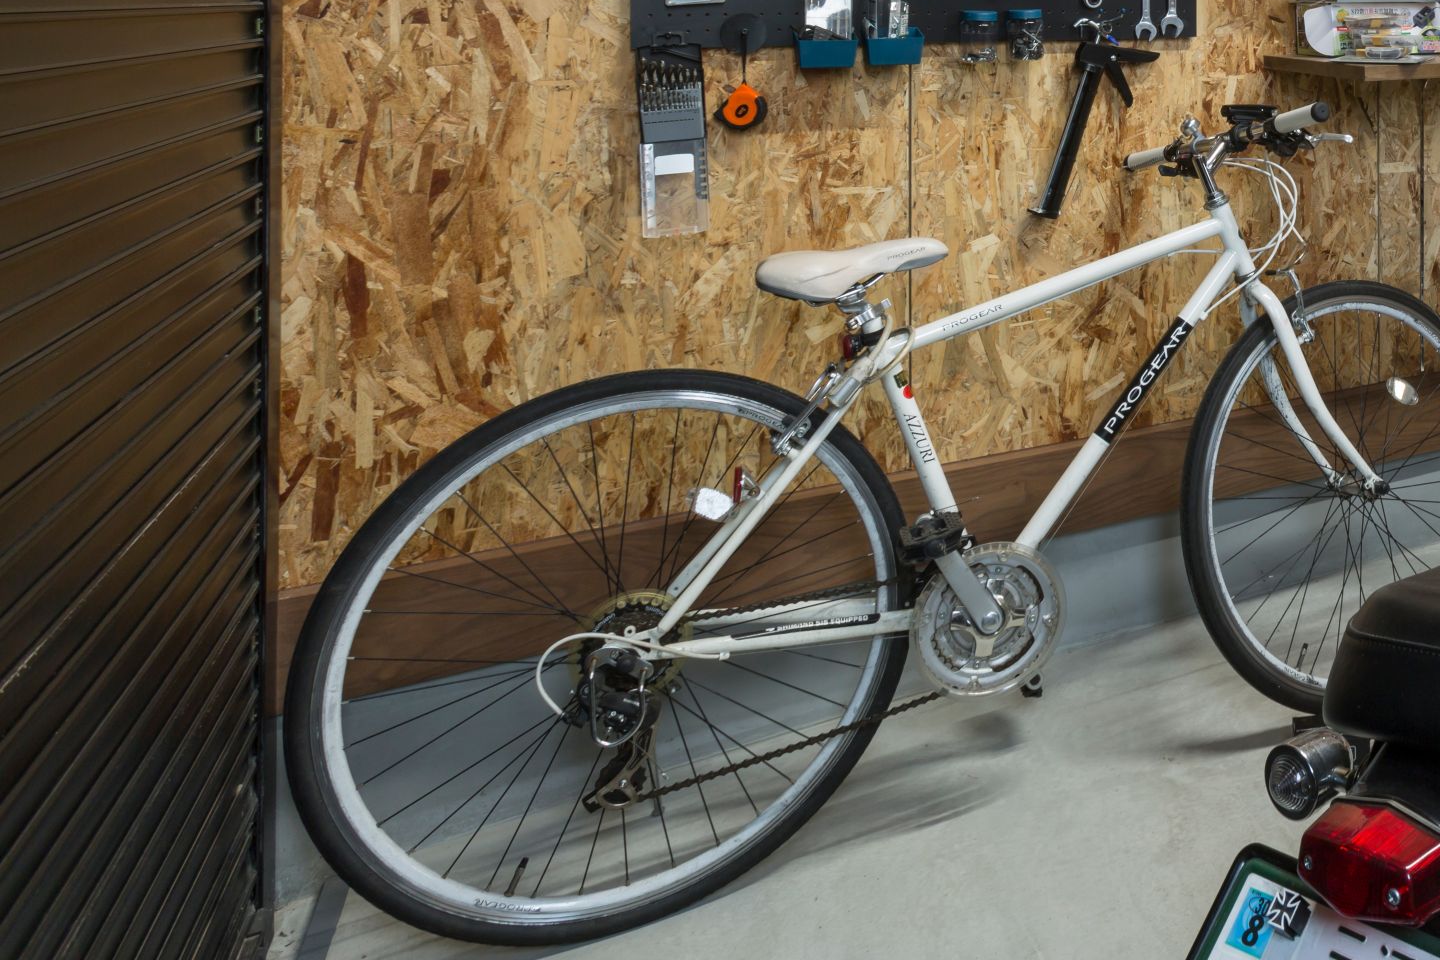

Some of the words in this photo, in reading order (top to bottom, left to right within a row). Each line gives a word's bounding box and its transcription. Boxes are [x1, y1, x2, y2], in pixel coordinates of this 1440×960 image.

[887, 246, 926, 260] PROGEAR
[942, 304, 1003, 331] PROGEAR
[1103, 325, 1187, 435] PROGEAR
[903, 413, 936, 464] AZZURI
[830, 614, 869, 625] EQUIPPED
[1254, 897, 1271, 917] 30
[1241, 915, 1265, 947] 8
